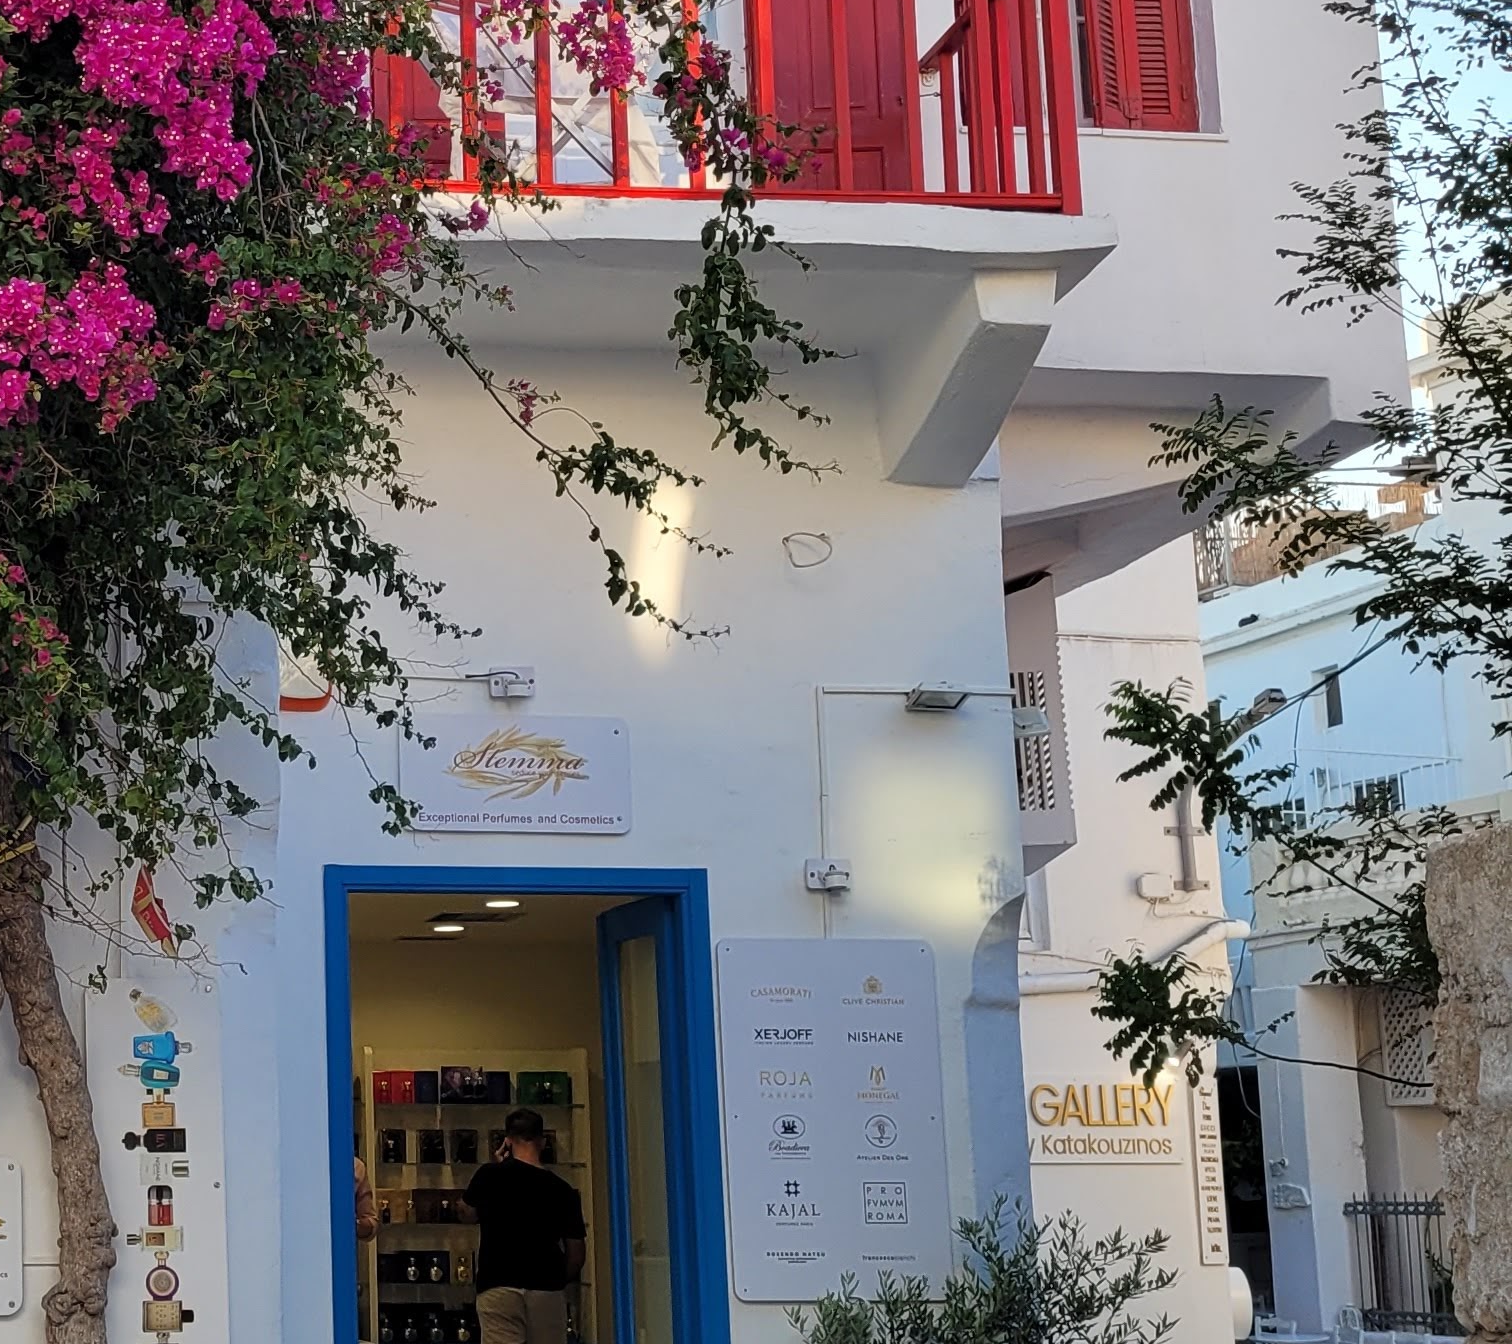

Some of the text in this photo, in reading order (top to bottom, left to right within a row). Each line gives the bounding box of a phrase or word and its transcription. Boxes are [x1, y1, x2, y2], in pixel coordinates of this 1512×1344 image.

[453, 742, 586, 773] Stemma
[418, 812, 615, 825] Exceptional Perfumes and Cosmetics
[750, 987, 812, 999] CASAMORATI
[754, 1028, 814, 1040] XERJOFF
[847, 1031, 904, 1043] NISHANE
[759, 1071, 812, 1086] ROJA
[1030, 1084, 1174, 1127] GALLERY
[1041, 1133, 1173, 1155] Katakouzinos
[766, 1203, 822, 1219] KAJAL
[867, 1212, 905, 1221] ROMA
